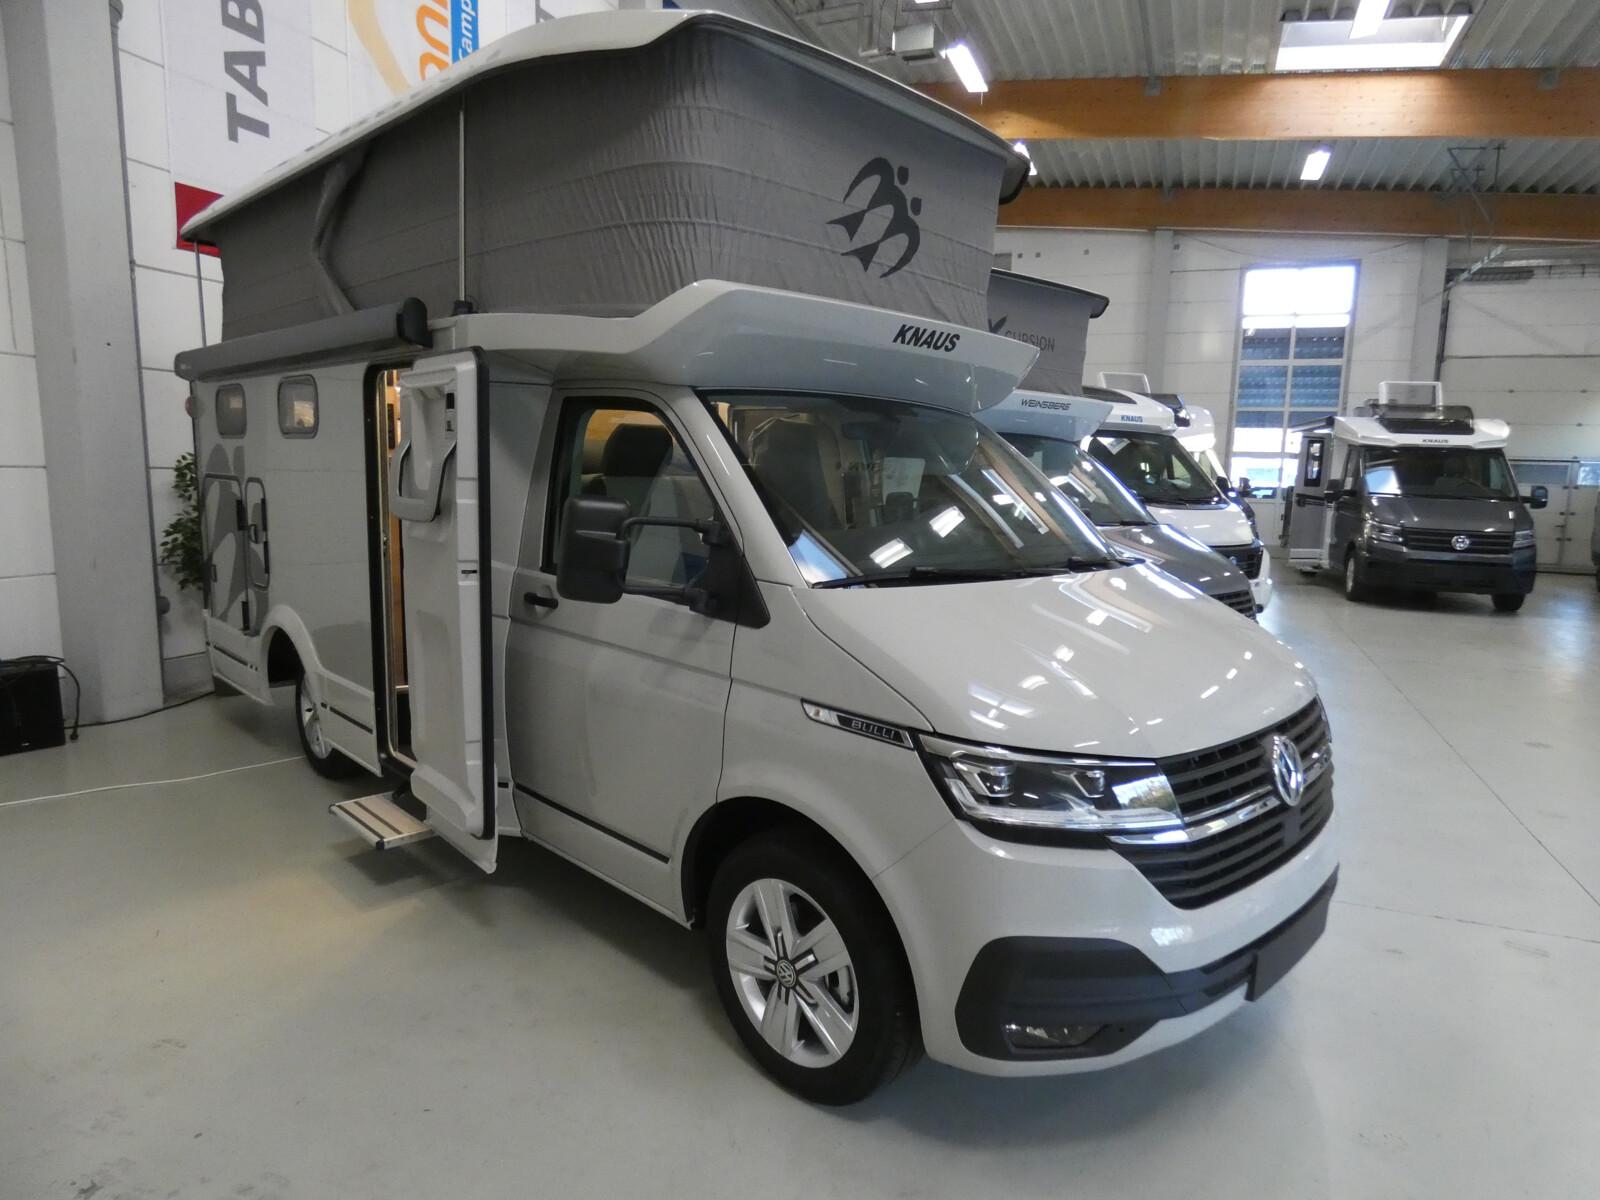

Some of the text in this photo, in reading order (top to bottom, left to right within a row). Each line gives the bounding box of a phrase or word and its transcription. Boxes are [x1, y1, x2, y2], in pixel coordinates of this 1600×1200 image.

[221, 0, 270, 143] TAB
[892, 324, 960, 352] KNAUS
[1120, 415, 1143, 423] KNAUS
[851, 720, 896, 740] BULLI
